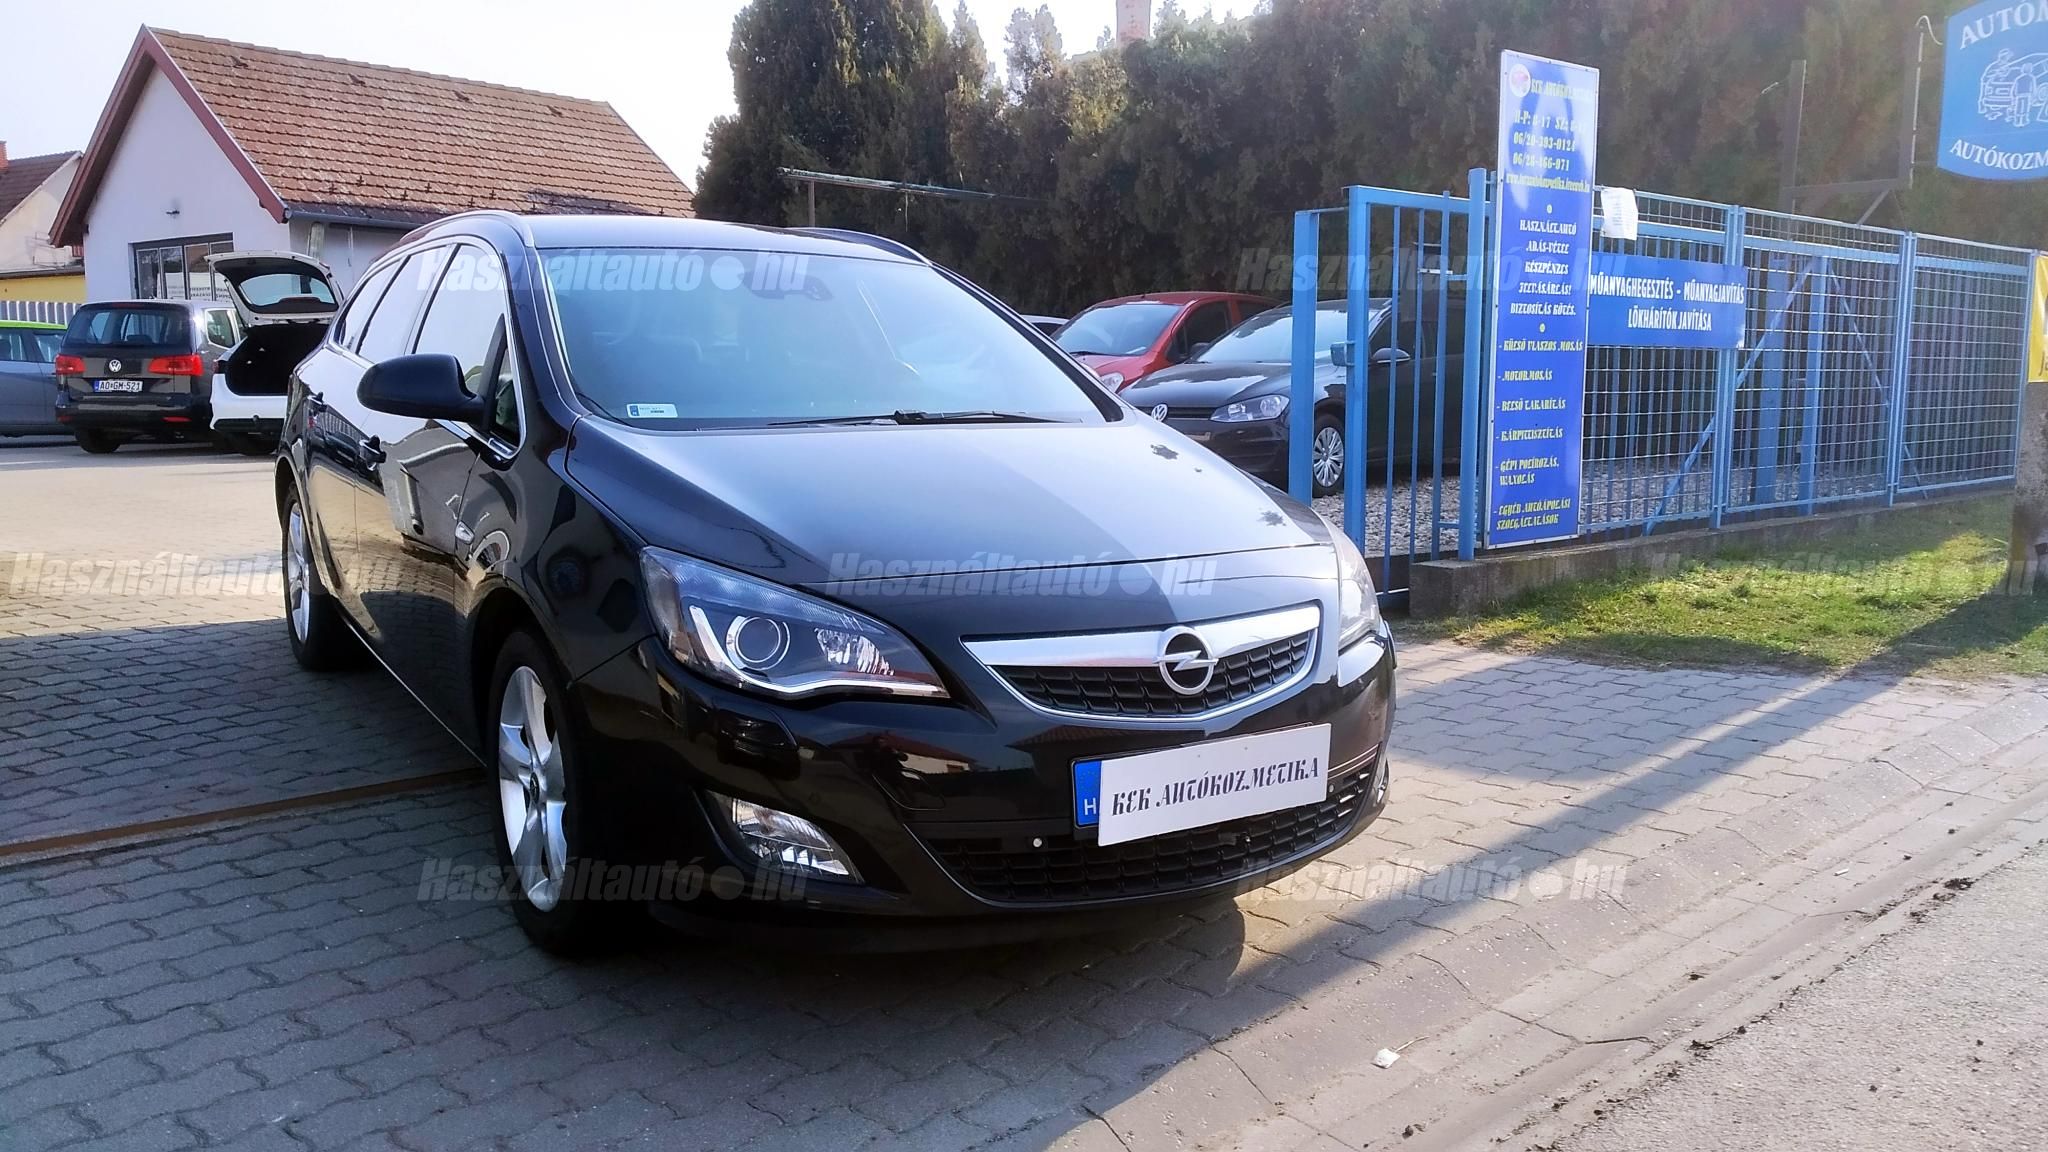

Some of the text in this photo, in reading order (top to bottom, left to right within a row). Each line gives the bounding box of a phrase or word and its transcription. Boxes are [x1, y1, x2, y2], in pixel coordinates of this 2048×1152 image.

[1590, 271, 1674, 300] MŰANYAGHEGESZTÉS
[1684, 279, 1745, 305] MŰANYAGJAVÍTÁS
[1677, 308, 1712, 332] JAVÍTÁSA
[1557, 339, 1584, 352] MOSÁS
[1524, 397, 1566, 411] TAKARÍTÁS
[1155, 757, 1320, 808] AUTÓKOZMETIKA
[1084, 797, 1097, 816] H
